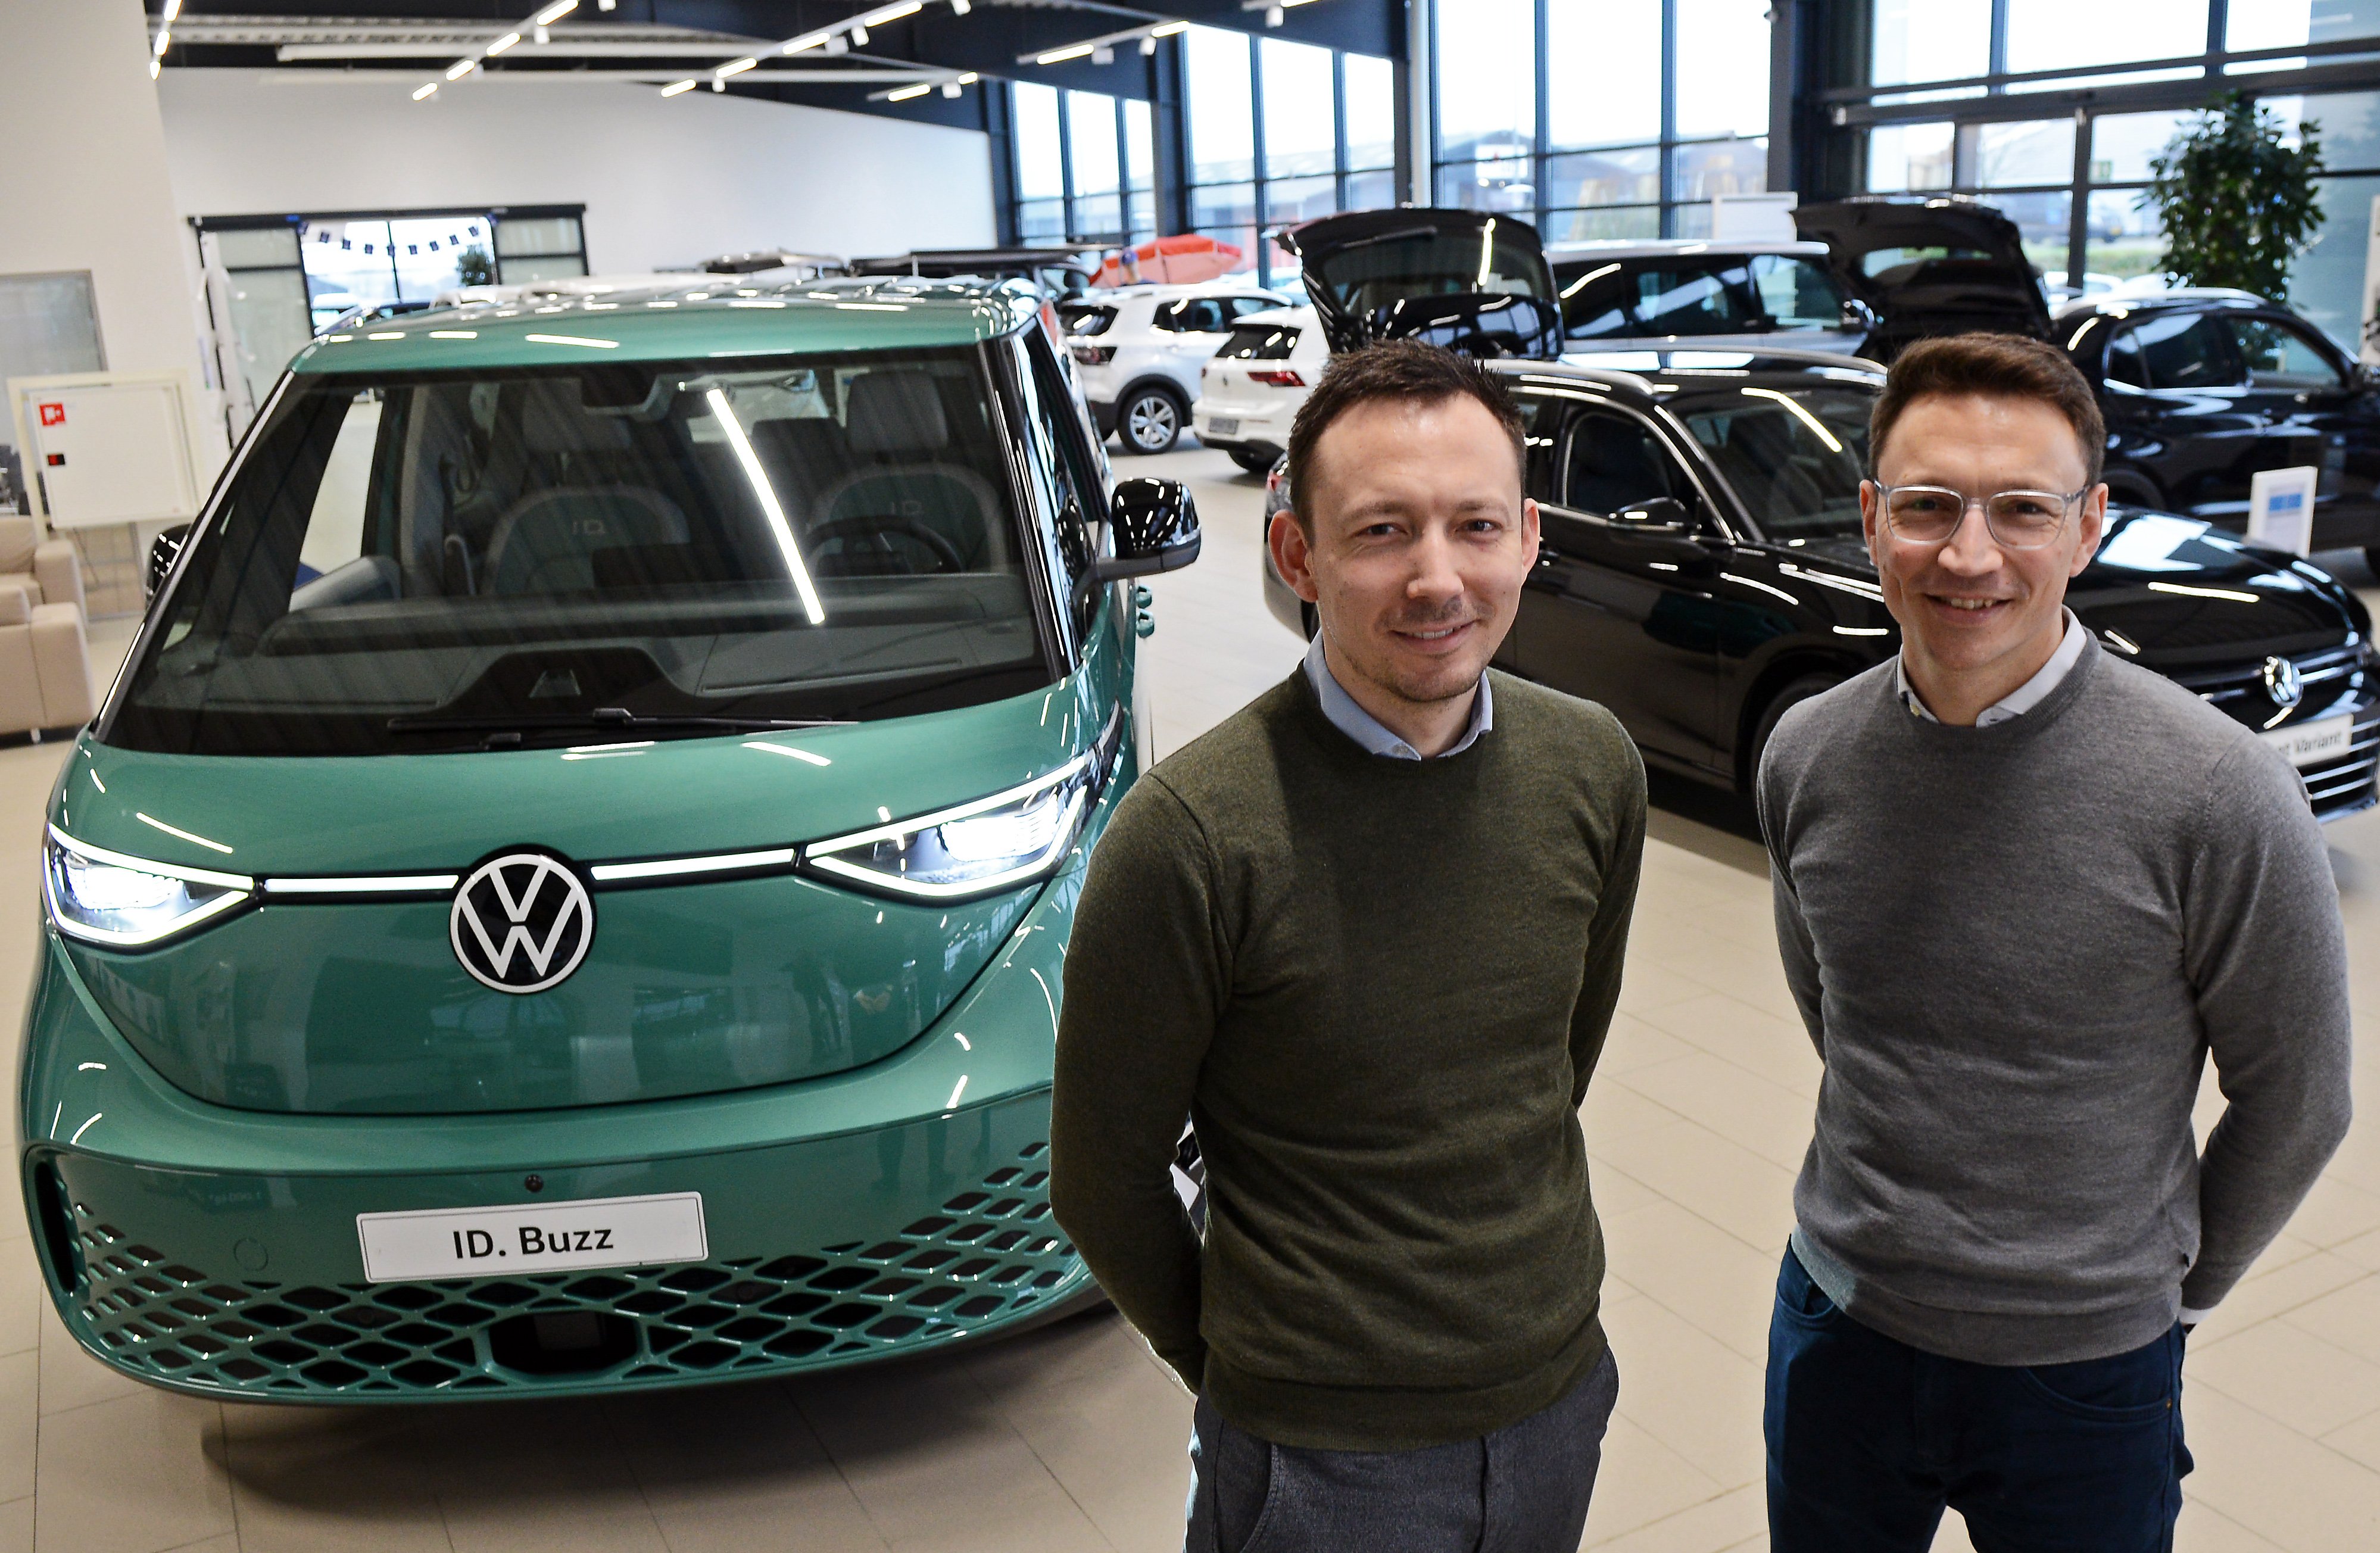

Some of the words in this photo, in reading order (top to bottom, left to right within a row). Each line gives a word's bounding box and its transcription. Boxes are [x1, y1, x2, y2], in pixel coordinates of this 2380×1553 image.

[457, 860, 586, 983] VW
[453, 1230, 506, 1259] ID.
[519, 1226, 614, 1255] Buzz
